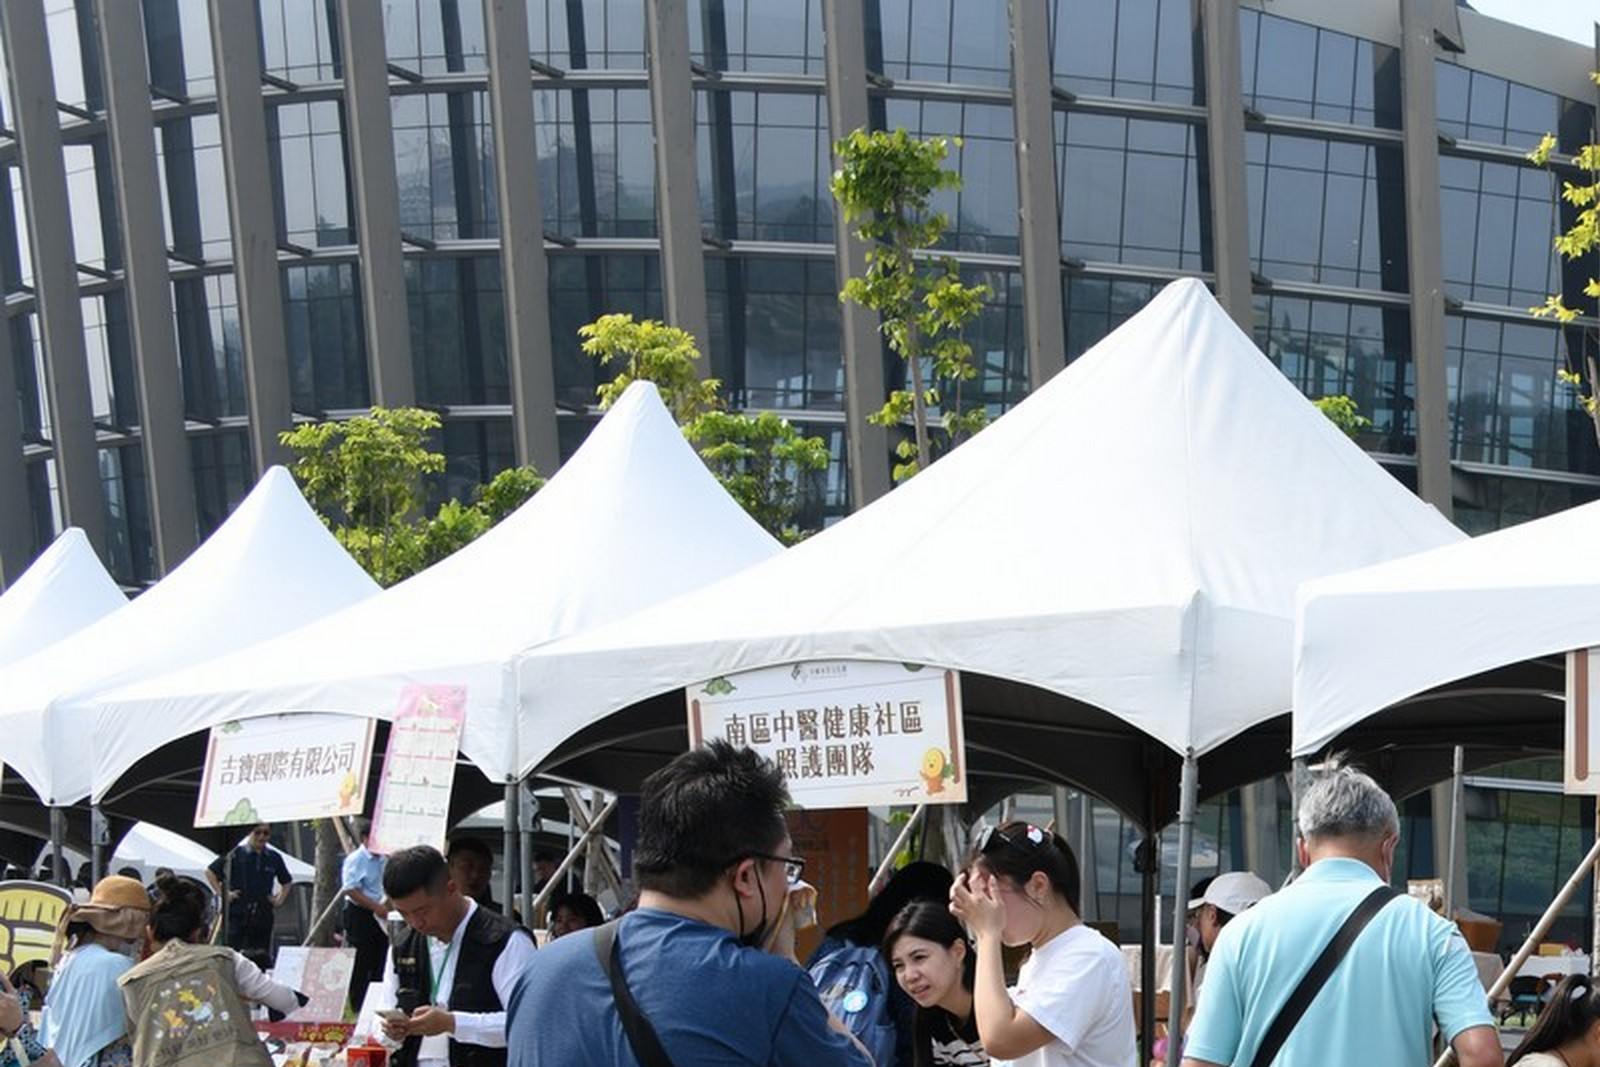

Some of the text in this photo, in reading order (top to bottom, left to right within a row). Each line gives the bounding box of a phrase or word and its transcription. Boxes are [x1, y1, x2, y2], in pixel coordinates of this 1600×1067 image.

[724, 700, 923, 746] 南區中醫健康社區
[220, 741, 356, 786] 吉寶國際有限公司
[775, 741, 875, 780] 照護團隊
